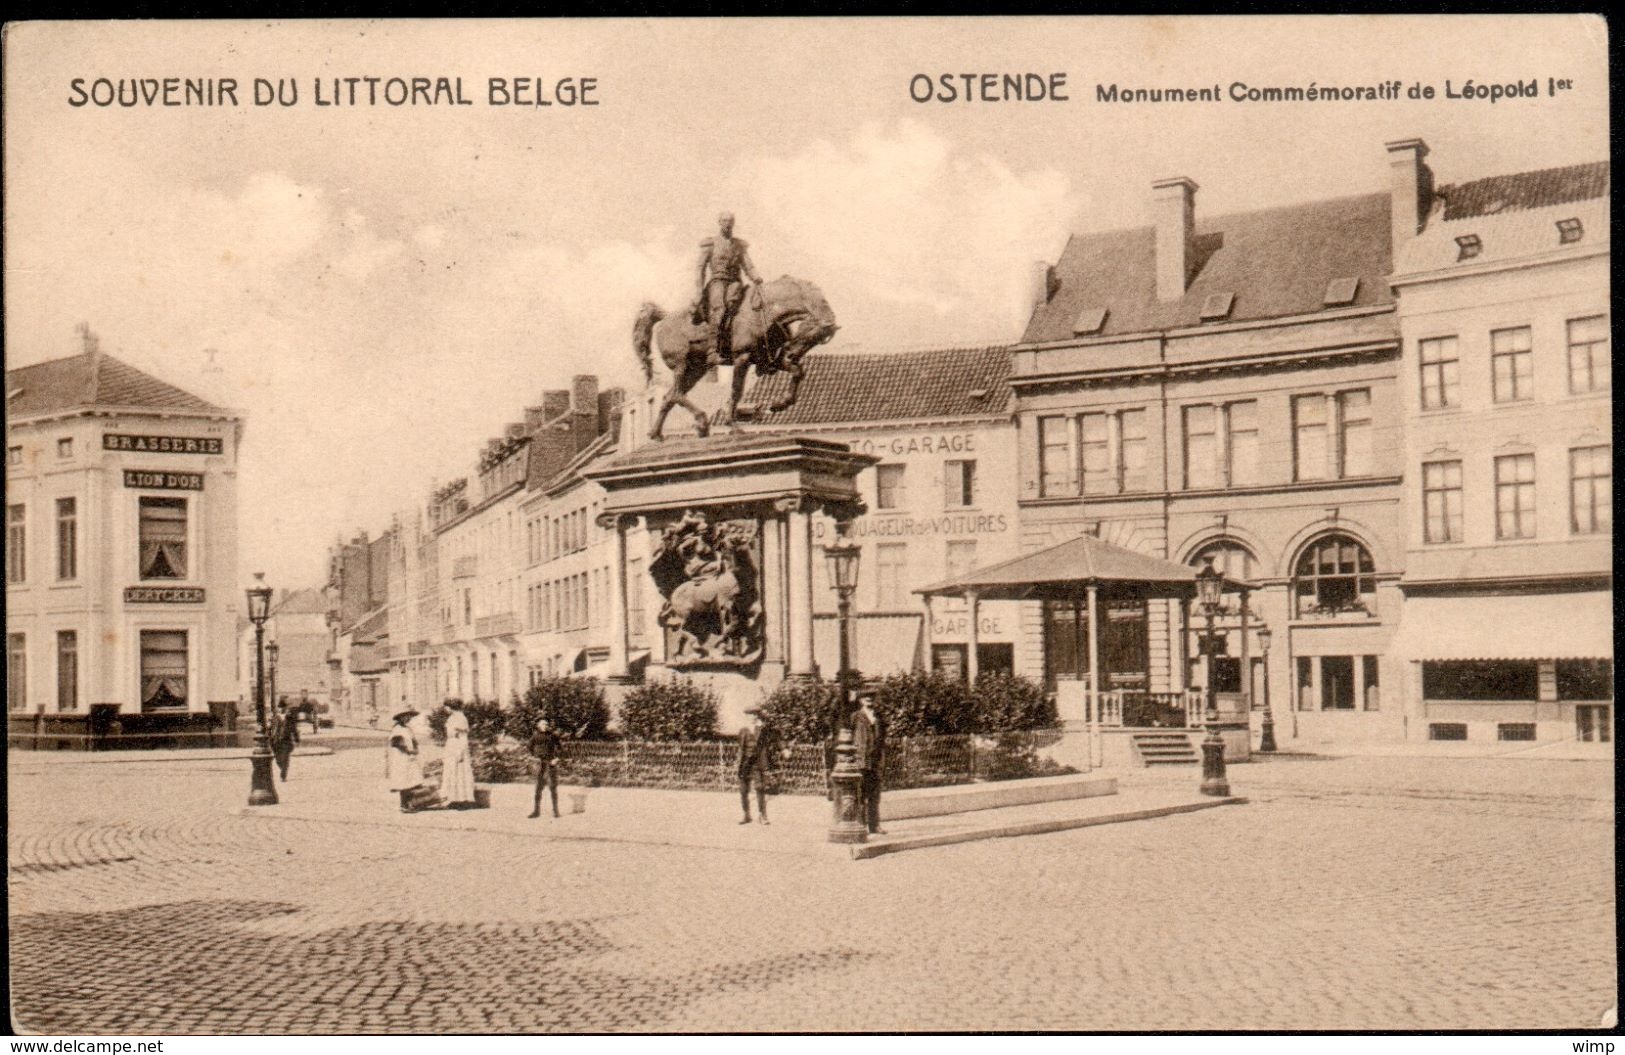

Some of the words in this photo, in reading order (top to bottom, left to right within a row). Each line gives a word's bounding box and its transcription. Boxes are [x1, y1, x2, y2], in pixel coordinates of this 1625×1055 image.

[106, 435, 219, 454] BRASSERIE
[848, 433, 975, 455] TO-GARAGE
[126, 472, 165, 487] LION
[931, 514, 1009, 535] VOITURES
[933, 617, 1003, 635] GARGE
